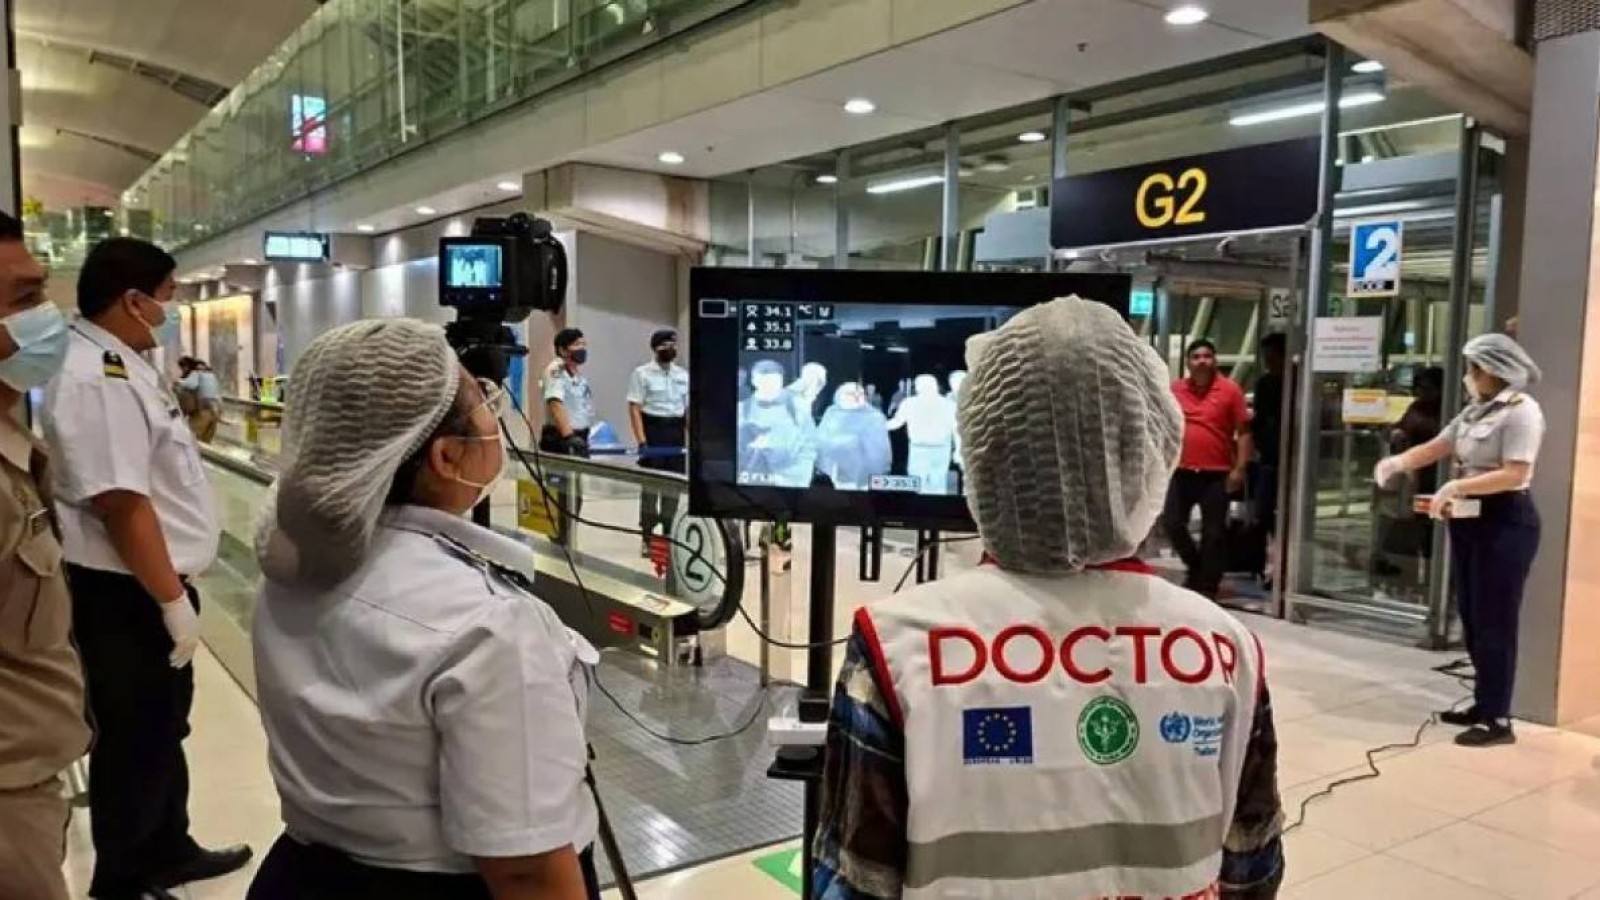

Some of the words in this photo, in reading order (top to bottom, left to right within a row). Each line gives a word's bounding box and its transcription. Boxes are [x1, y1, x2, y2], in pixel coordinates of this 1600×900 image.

[1135, 168, 1208, 228] G2
[1363, 228, 1398, 279] 2
[764, 321, 792, 333] 35.1
[685, 523, 704, 582] 2
[928, 624, 1235, 685] DOCTOR
